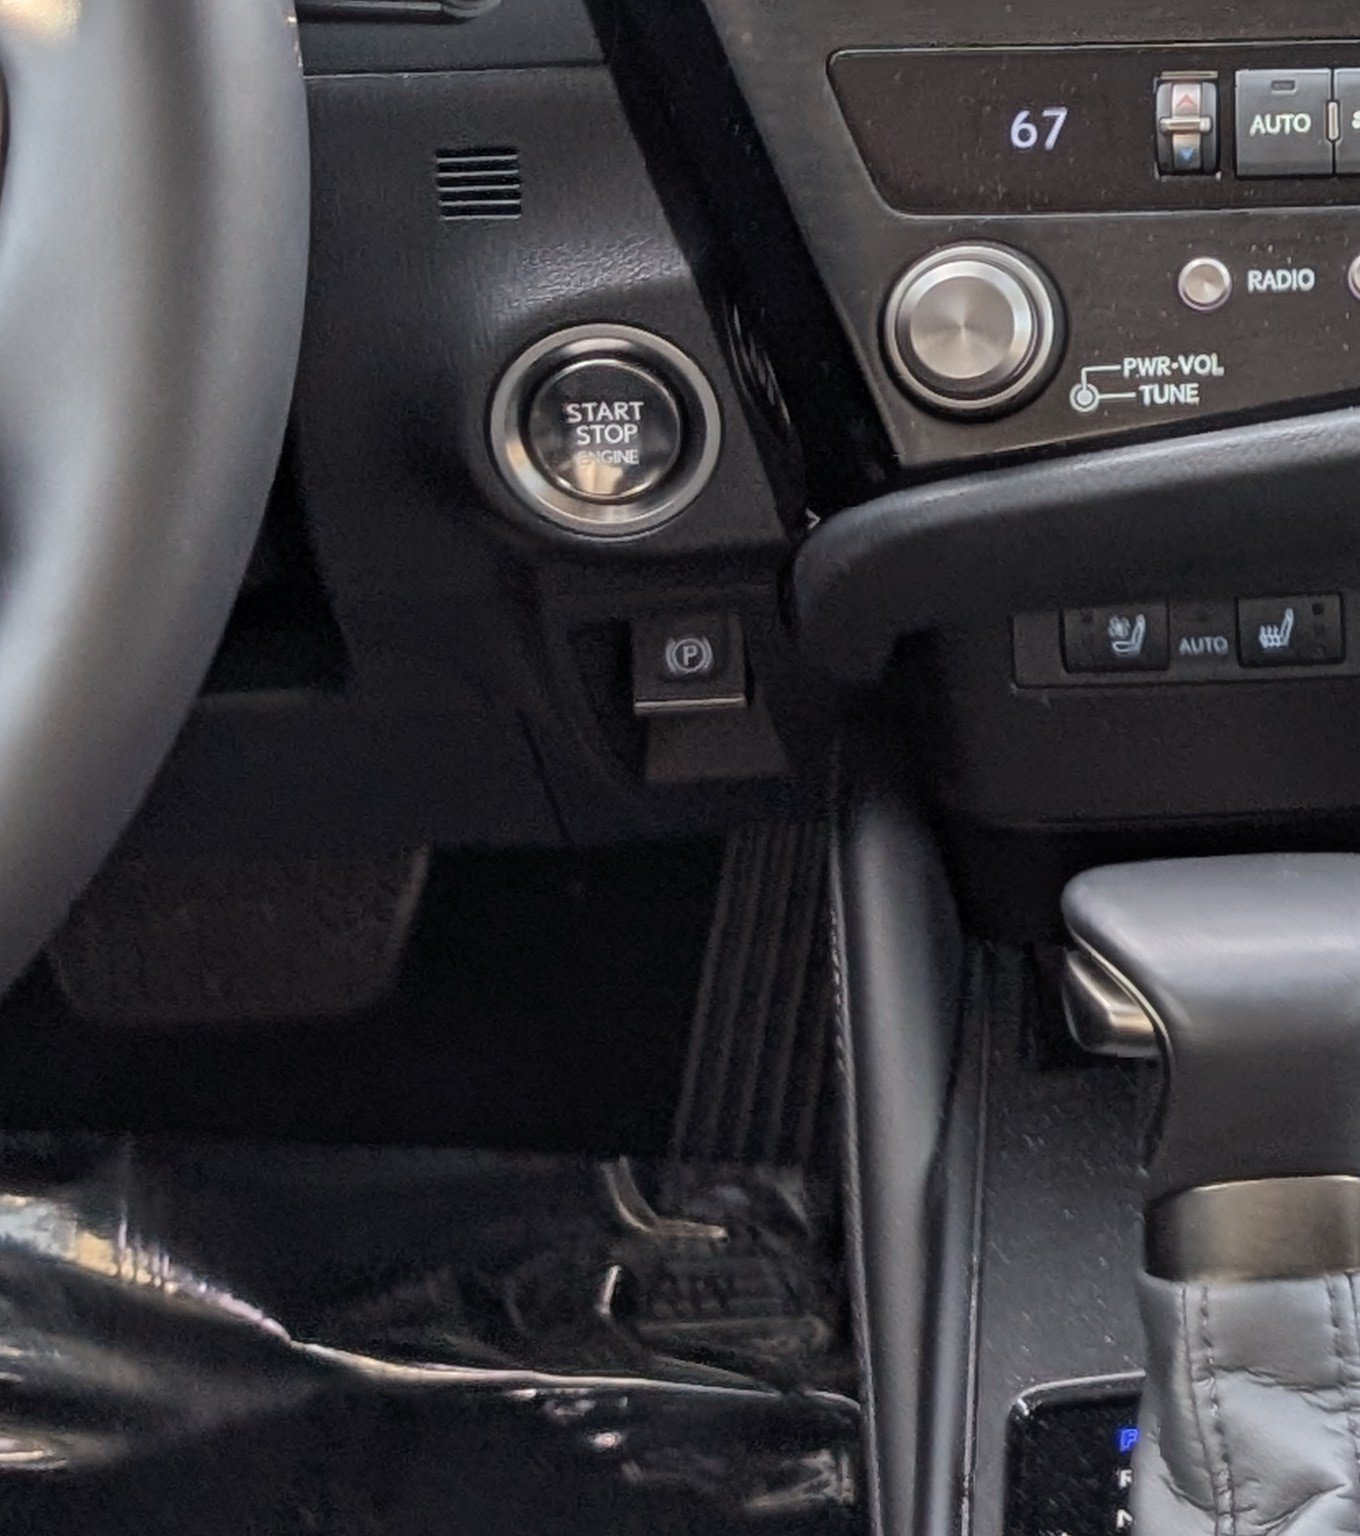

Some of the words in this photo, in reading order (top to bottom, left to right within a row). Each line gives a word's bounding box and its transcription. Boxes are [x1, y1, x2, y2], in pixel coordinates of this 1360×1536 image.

[1010, 106, 1068, 151] 67
[1249, 112, 1312, 136] AUTO
[1247, 268, 1315, 293] RADIO
[1122, 353, 1224, 378] PWR-VOL
[1140, 382, 1199, 406] TUNE
[566, 401, 644, 423] START
[576, 423, 638, 445] STOP
[577, 449, 639, 465] ENGINE
[1178, 635, 1229, 656] AUTO
